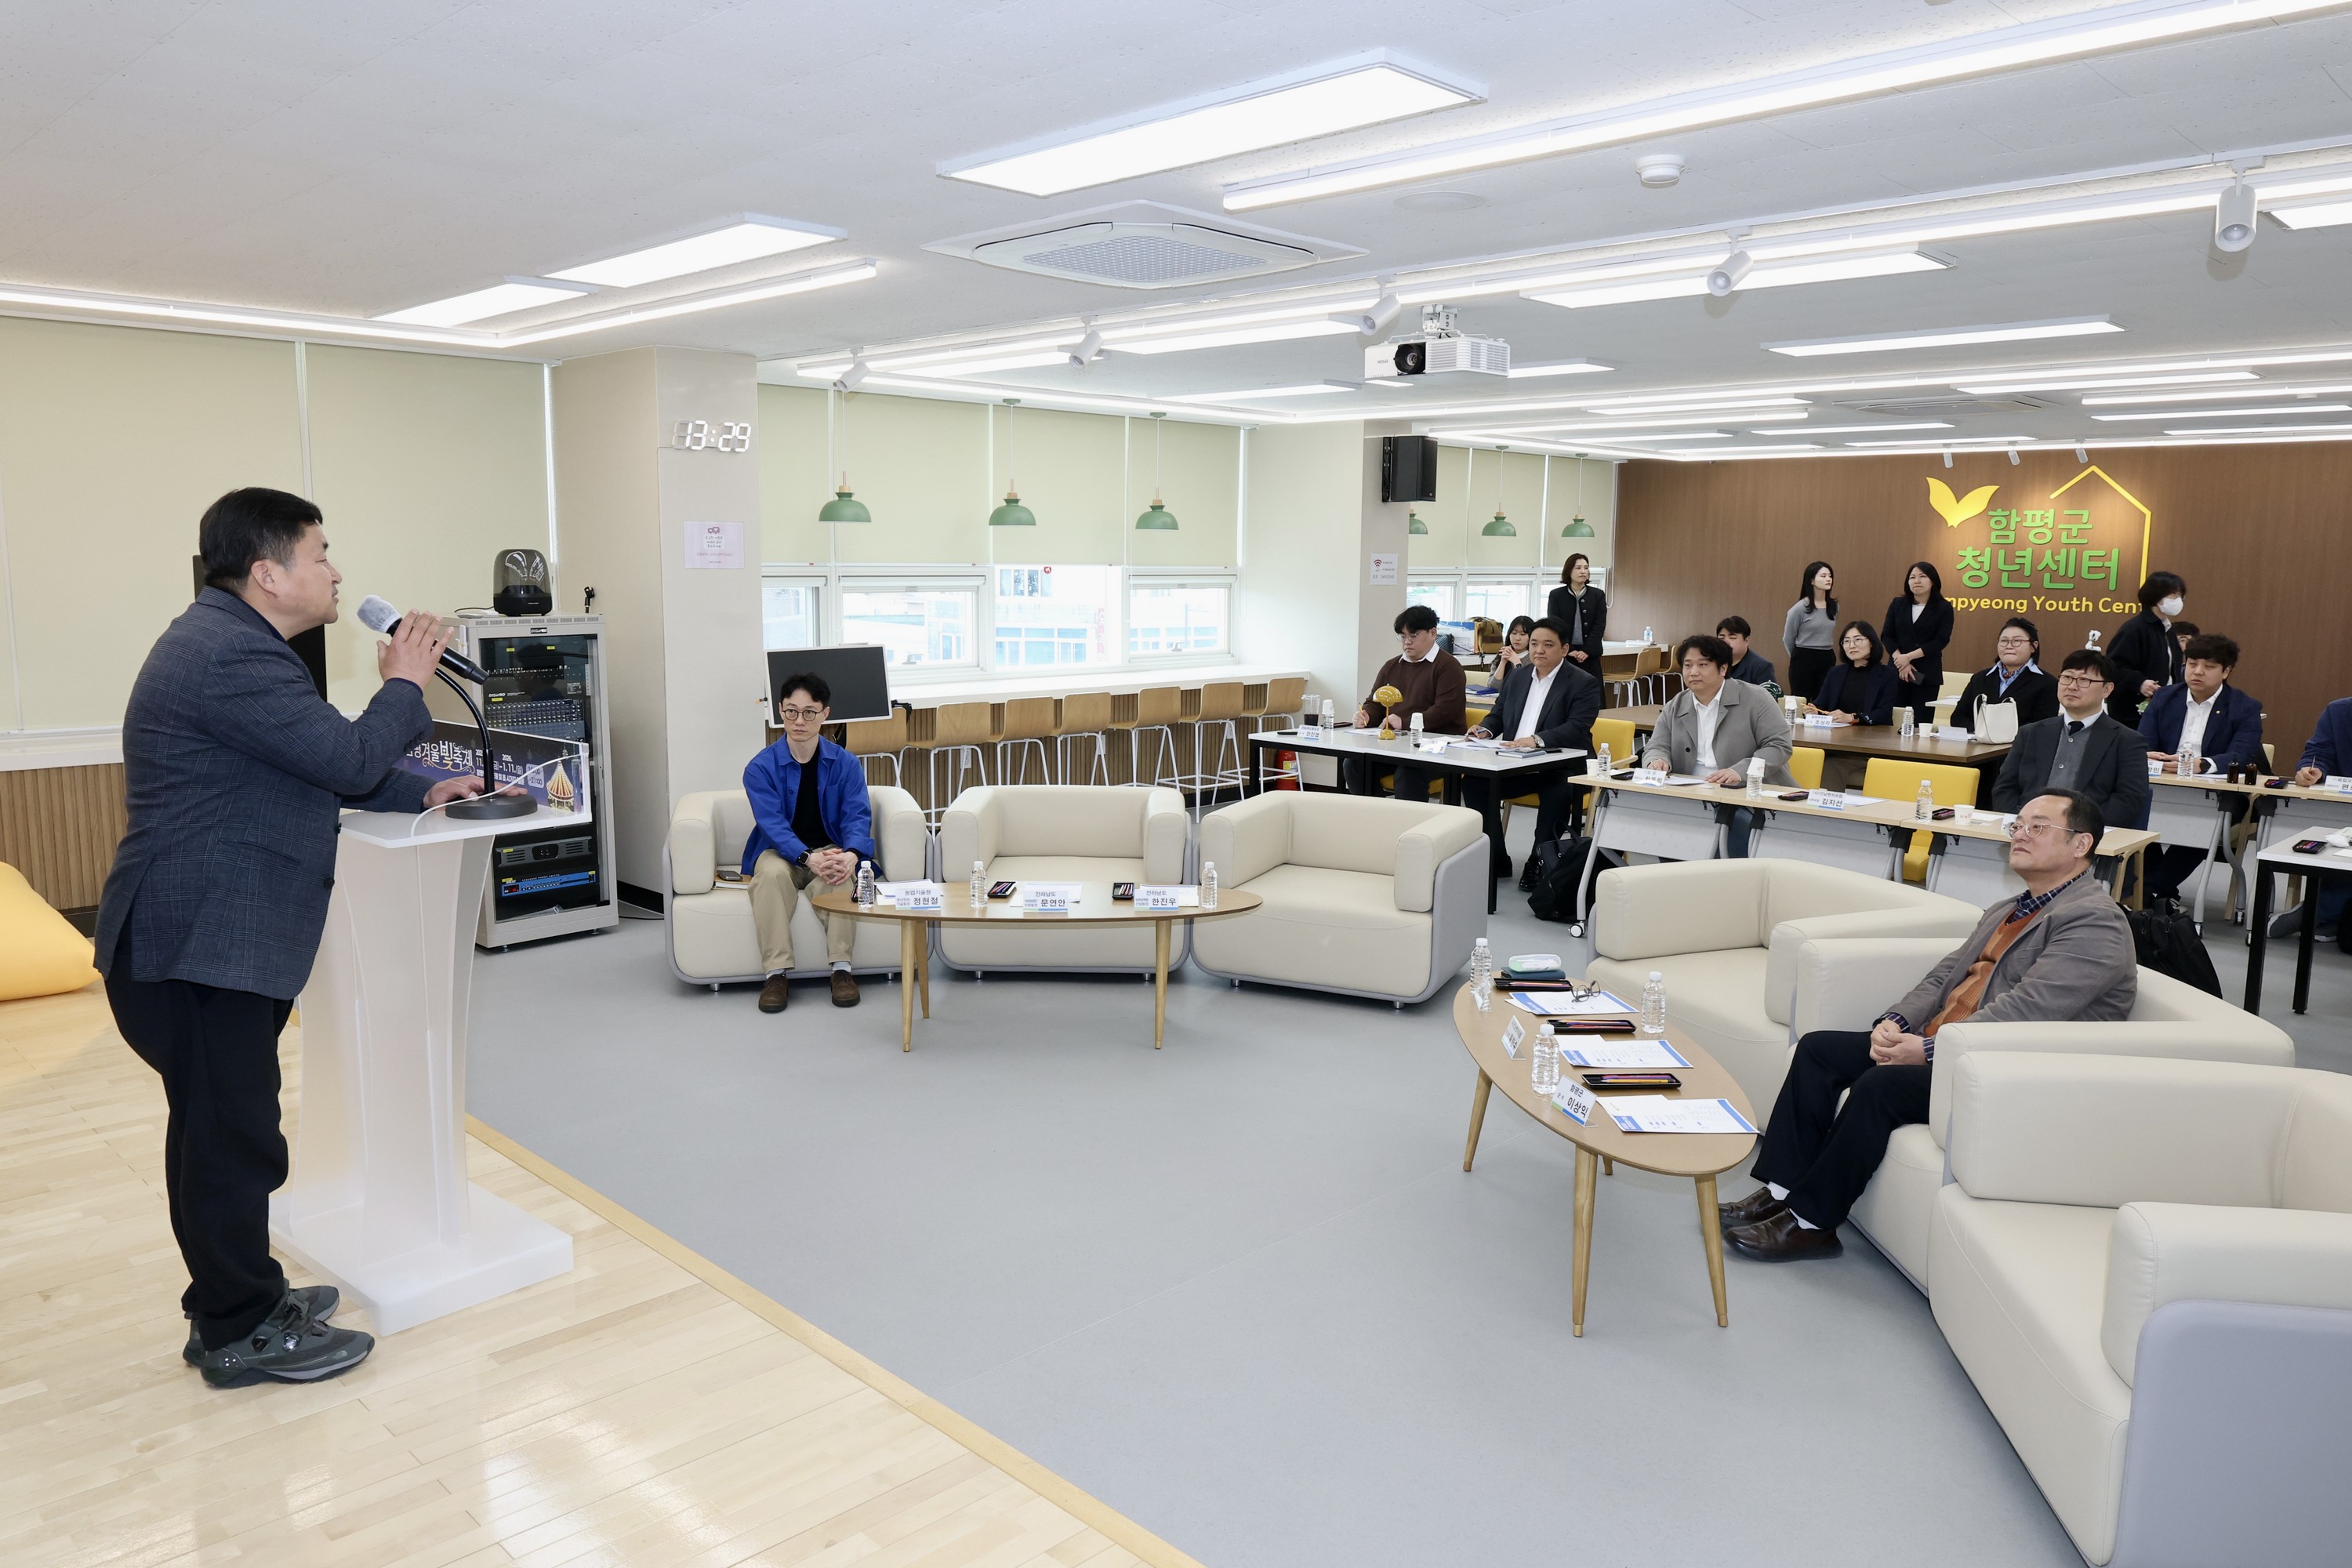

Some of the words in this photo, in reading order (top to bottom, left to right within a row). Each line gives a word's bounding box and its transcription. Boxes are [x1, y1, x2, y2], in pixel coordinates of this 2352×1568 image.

[684, 419, 752, 452] 13:29
[1987, 507, 2094, 545] 함평군
[1955, 546, 2120, 591] 청년센터
[1944, 596, 2028, 614] mpyeong
[2032, 595, 2093, 613] Youth
[2098, 597, 2143, 614] Cen
[406, 740, 474, 771] 평겨울빛축제
[1822, 798, 1843, 807] 김지선
[913, 897, 938, 906] 정현철
[1040, 898, 1065, 907] 문연안
[1152, 898, 1176, 906] 한진우
[1570, 1083, 1584, 1098] 함평군
[1567, 1097, 1589, 1118] 이상익
